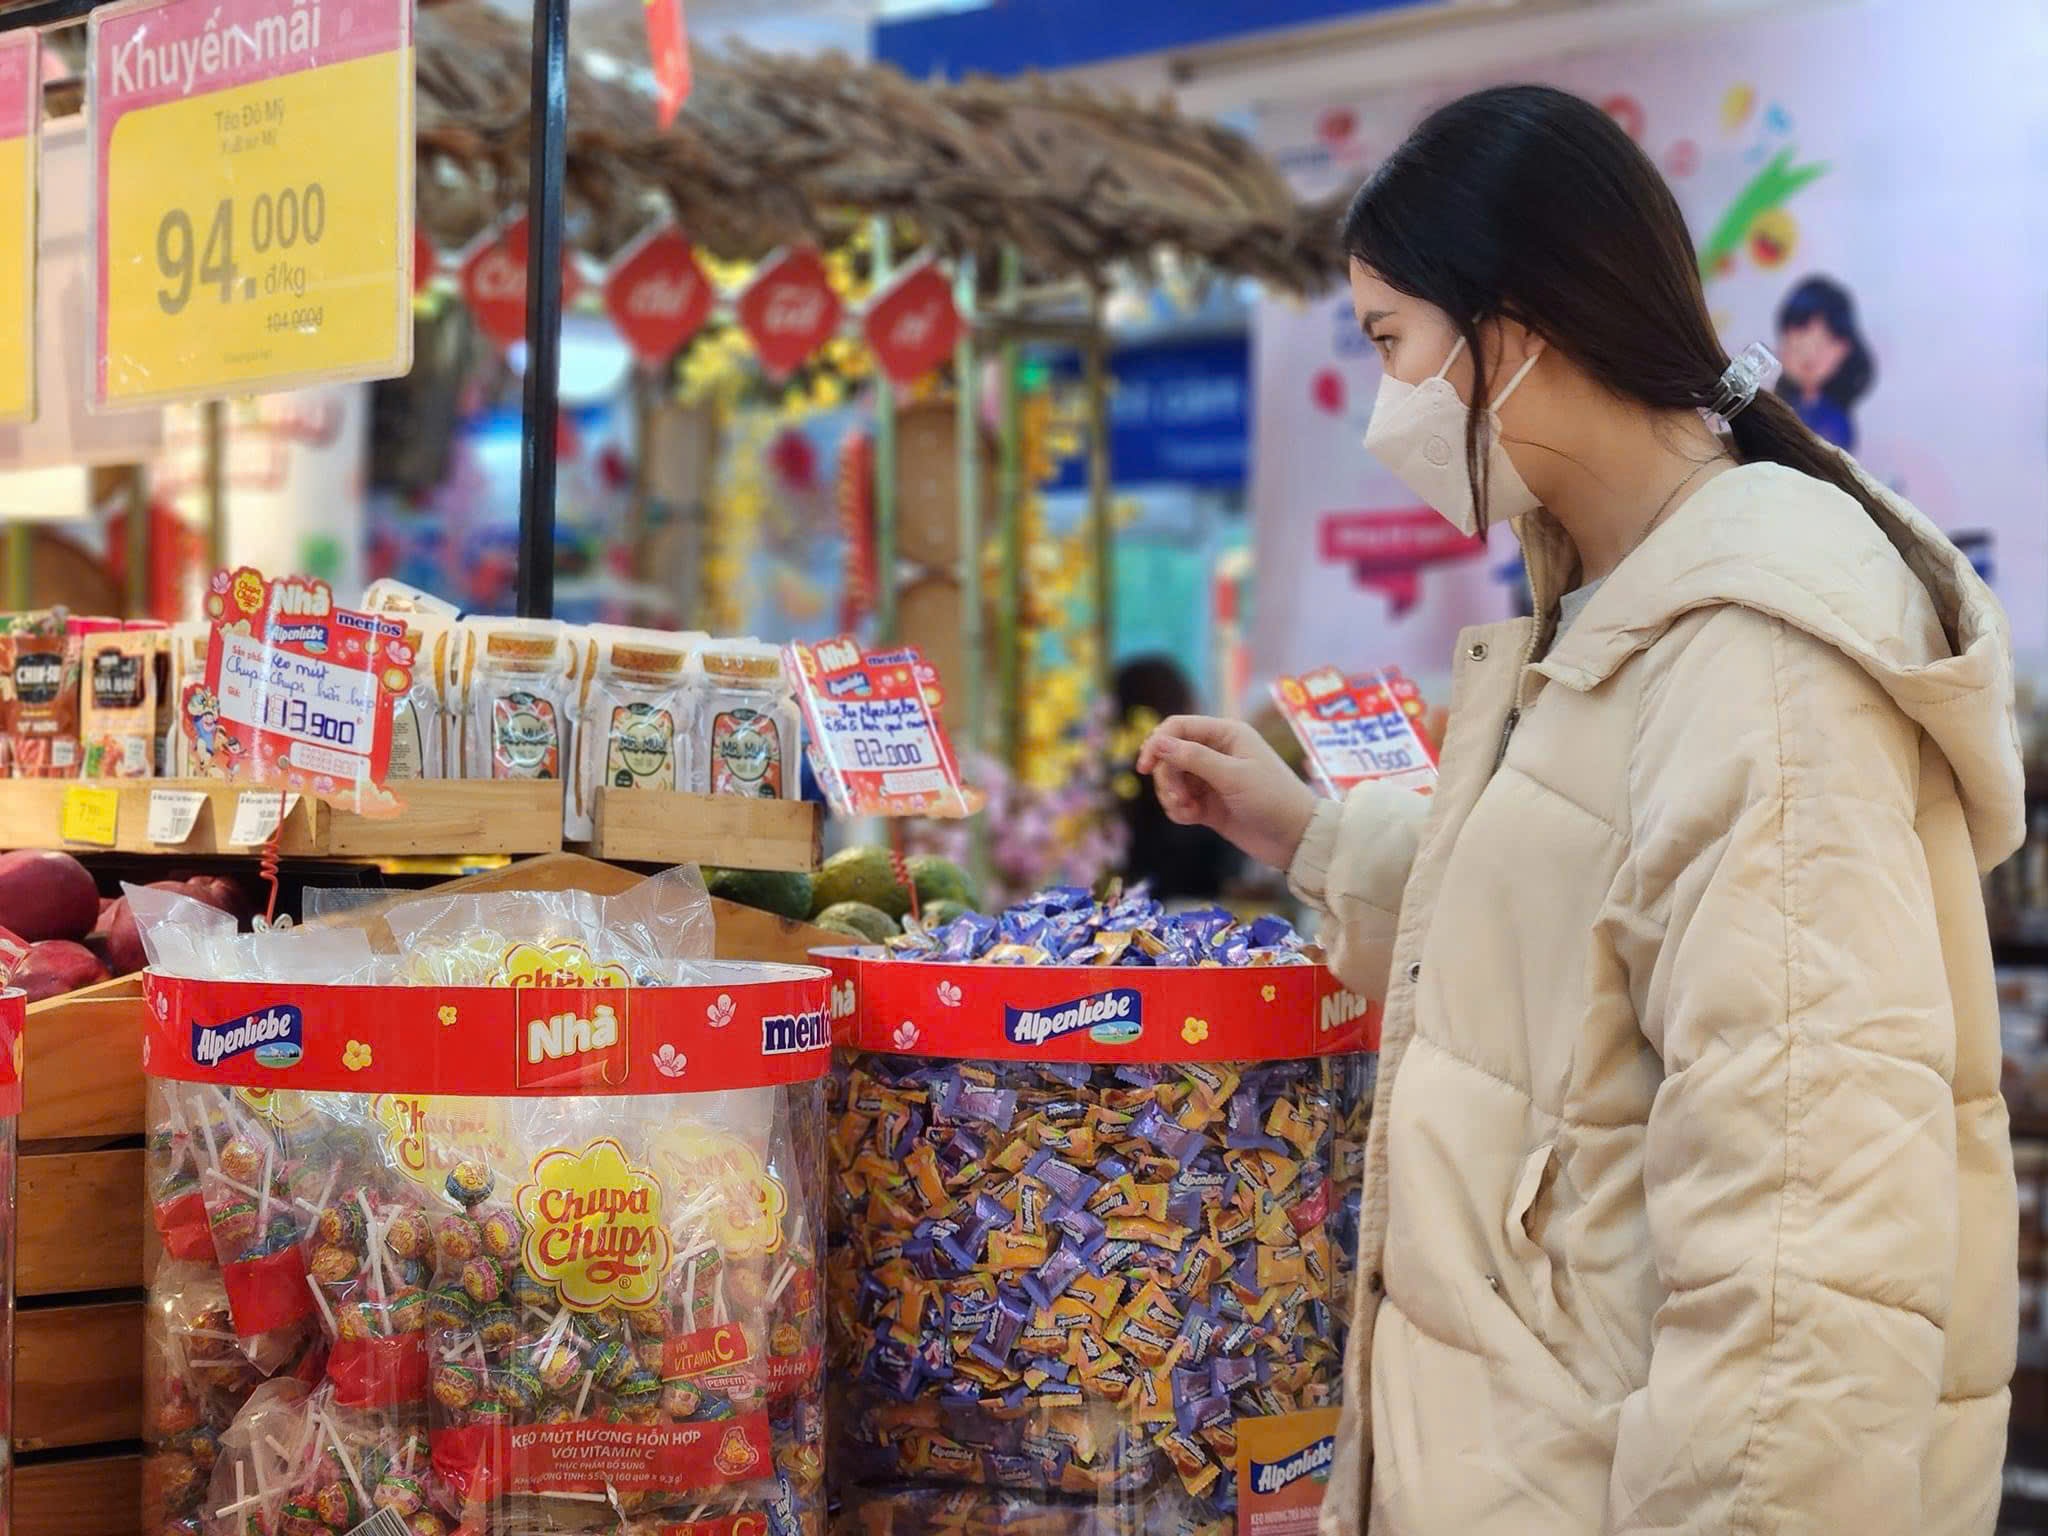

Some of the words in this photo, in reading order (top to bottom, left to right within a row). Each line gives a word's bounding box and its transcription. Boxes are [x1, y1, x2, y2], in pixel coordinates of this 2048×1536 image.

[112, 6, 241, 96] Khuyến
[264, 263, 306, 298] đ/kg
[270, 626, 324, 644] Alpenliebe
[338, 613, 401, 636] mentos
[831, 979, 856, 1018] hà
[197, 1009, 291, 1067] Alpenliebe
[528, 1005, 618, 1064] Nhà
[763, 1004, 832, 1052] mento
[1014, 995, 1132, 1046] Alpenliebe
[539, 1186, 651, 1225] Chupa
[539, 1222, 657, 1284] Chups
[674, 1349, 717, 1371] VITAMIN
[714, 1329, 735, 1361] C
[707, 1376, 746, 1388] PERFETTI
[540, 1429, 573, 1444] MÚT
[576, 1428, 632, 1444] HƯƠNG
[636, 1424, 669, 1446] HỖN
[672, 1429, 701, 1447] HỢP
[552, 1445, 577, 1459] VỚI
[580, 1446, 641, 1459] VITAMIN
[644, 1448, 657, 1461] C
[620, 1461, 646, 1470] SUNG
